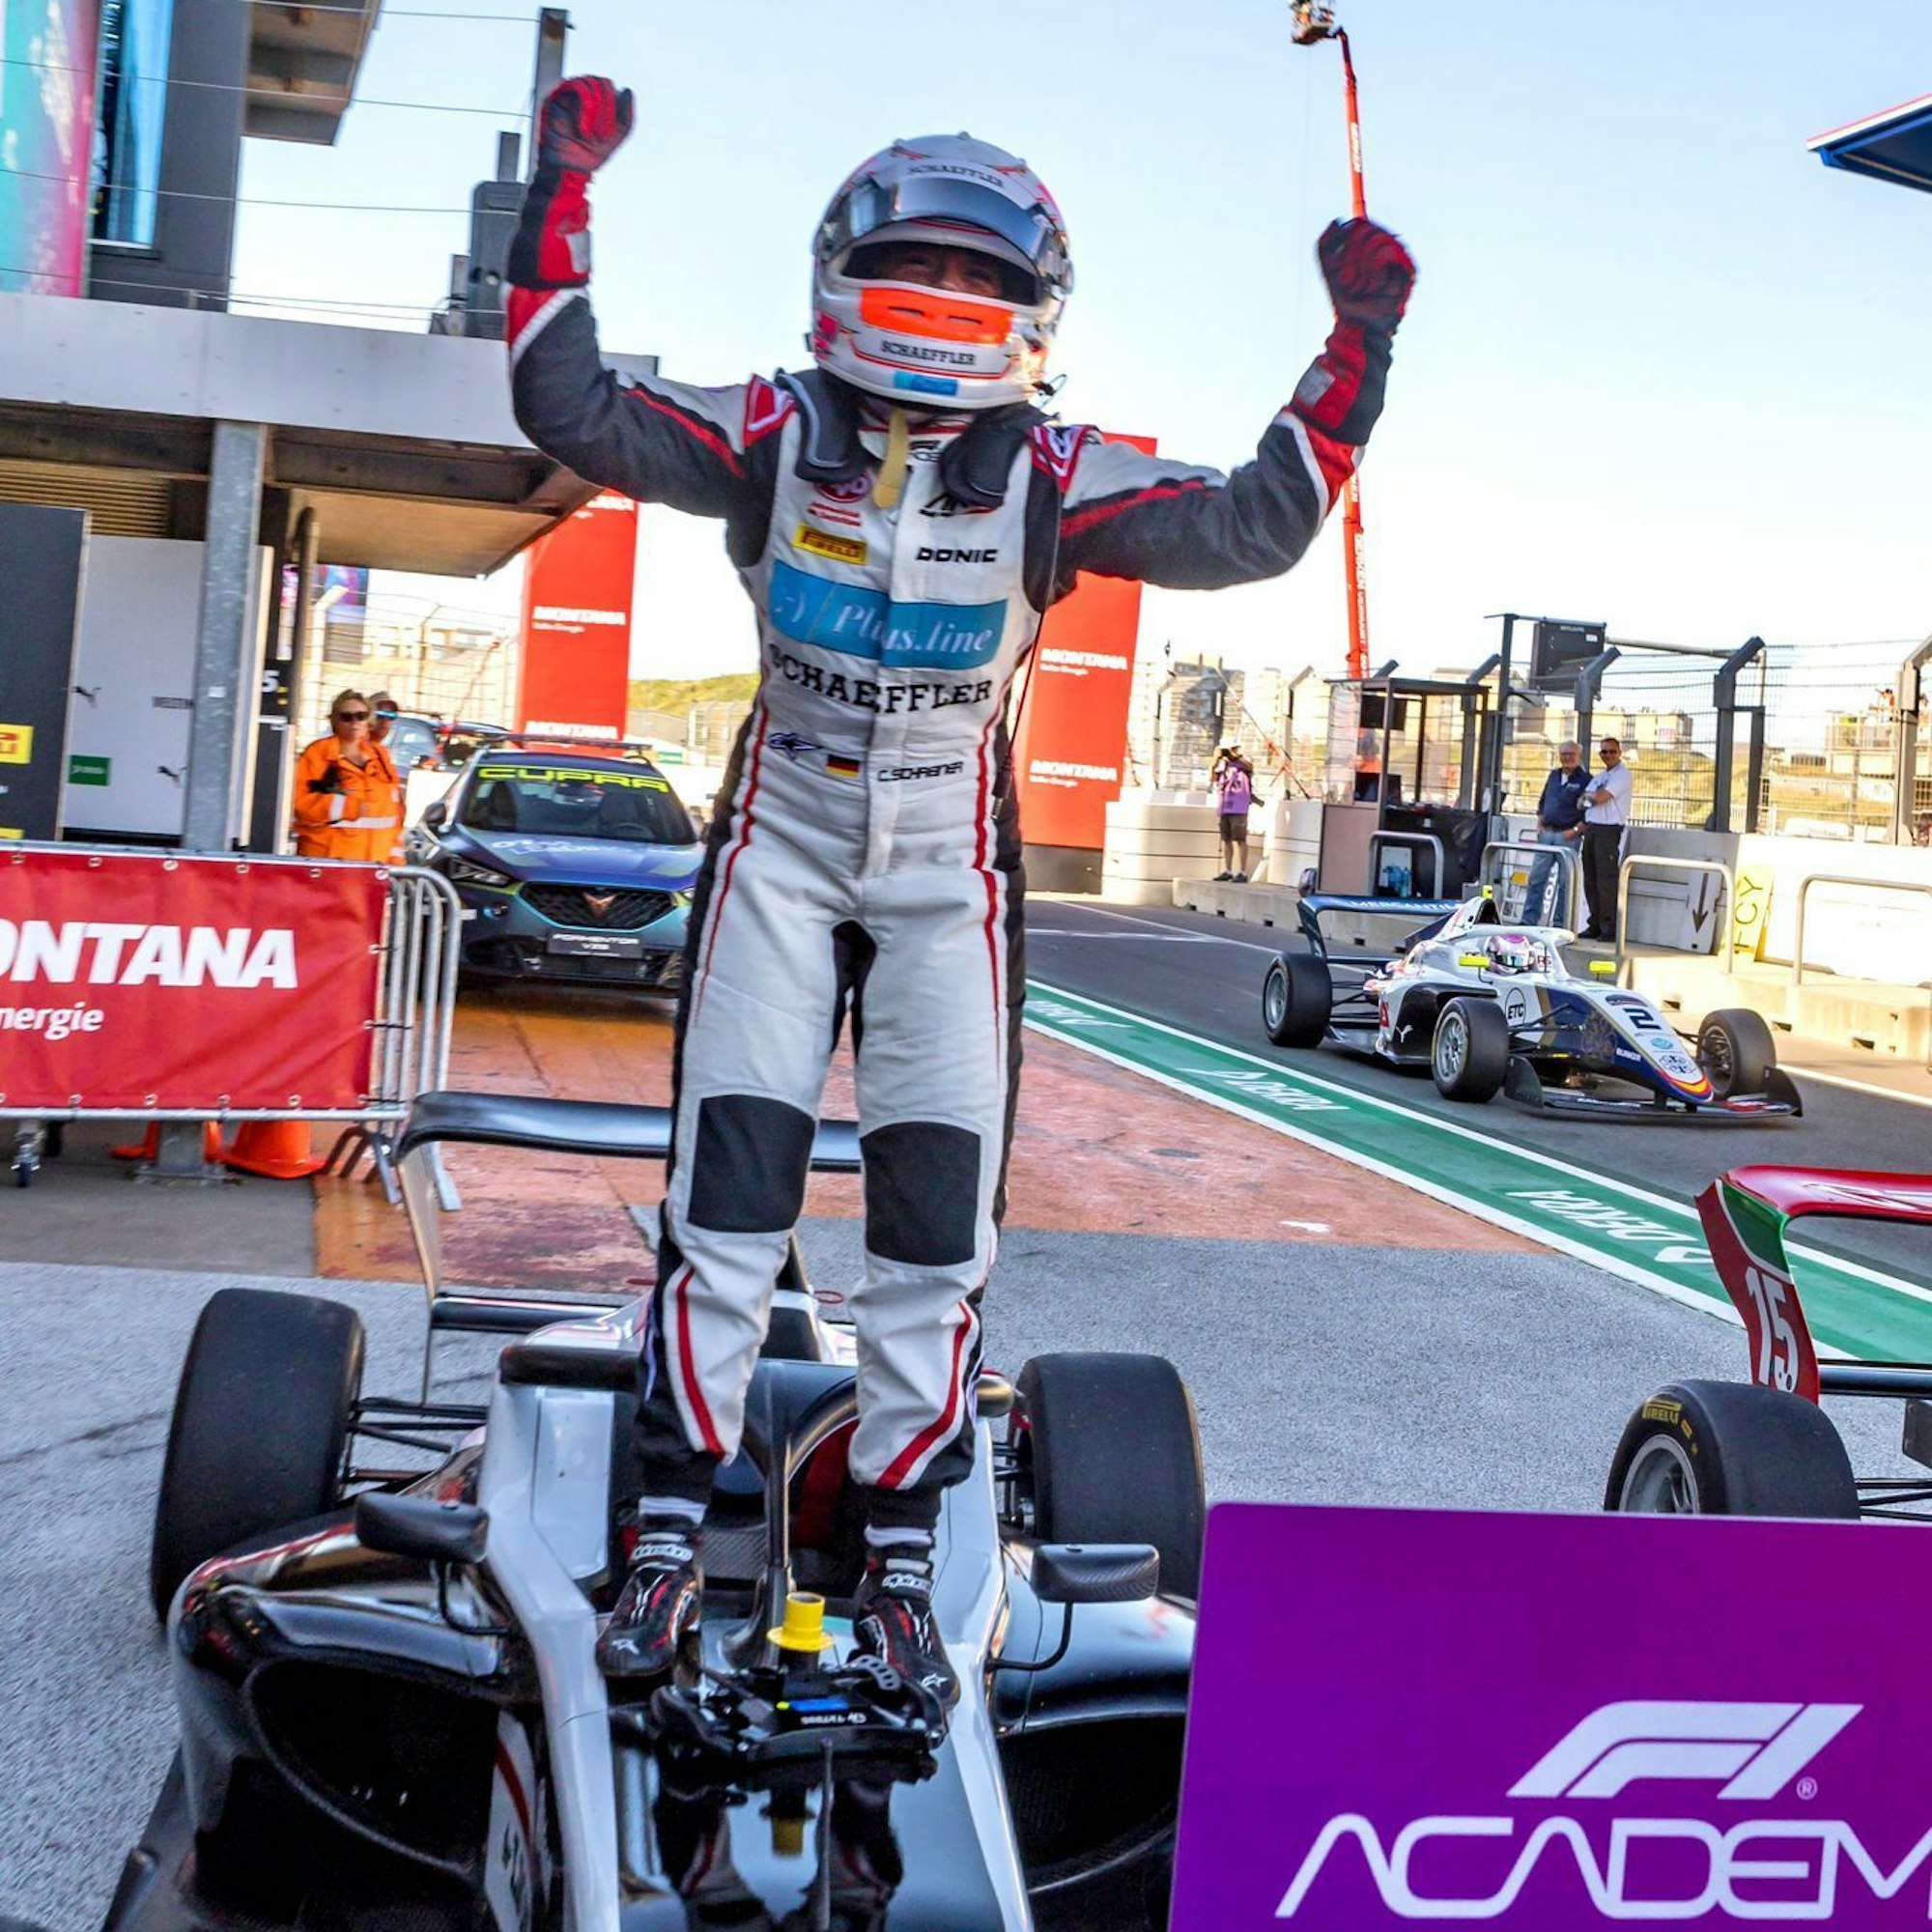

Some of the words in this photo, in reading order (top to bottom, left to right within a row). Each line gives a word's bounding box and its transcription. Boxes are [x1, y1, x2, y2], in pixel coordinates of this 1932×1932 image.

[907, 164, 1004, 186] SCHAEFFLER
[881, 340, 976, 366] SCHAEFFLER
[916, 547, 998, 563] DONIC
[833, 604, 994, 652] Plus.line
[769, 644, 993, 714] SCHAEFFLER
[479, 767, 669, 793] CUPRA
[1508, 1004, 1523, 1020] ETC
[1624, 1009, 1661, 1030] 2
[1745, 1266, 1799, 1392] 15
[1642, 1400, 1682, 1425] PIRELLI
[1506, 1700, 1864, 1800] F1
